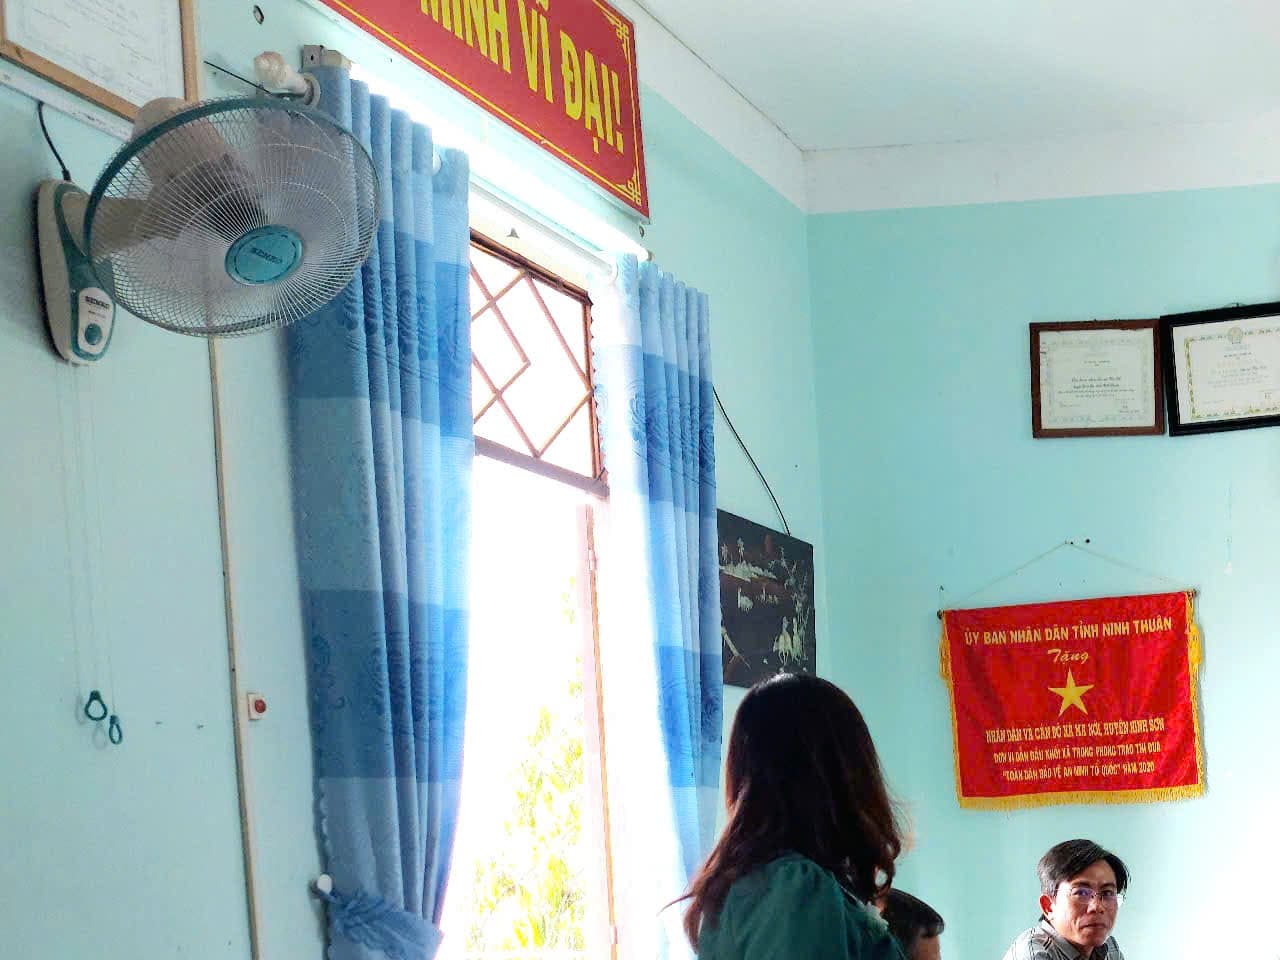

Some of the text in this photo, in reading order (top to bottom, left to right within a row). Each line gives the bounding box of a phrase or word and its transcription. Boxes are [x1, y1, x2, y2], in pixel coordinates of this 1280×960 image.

[560, 29, 624, 154] ĐẠI!
[983, 631, 1007, 646] BAN
[1009, 626, 1042, 644] NHÂN
[1044, 624, 1069, 641] DÂN
[1071, 620, 1099, 640] TỈNH
[1102, 621, 1130, 637] NINH
[1132, 614, 1172, 634] THUẬN
[1047, 648, 1089, 665] Tặng
[1139, 761, 1155, 774] 2020
